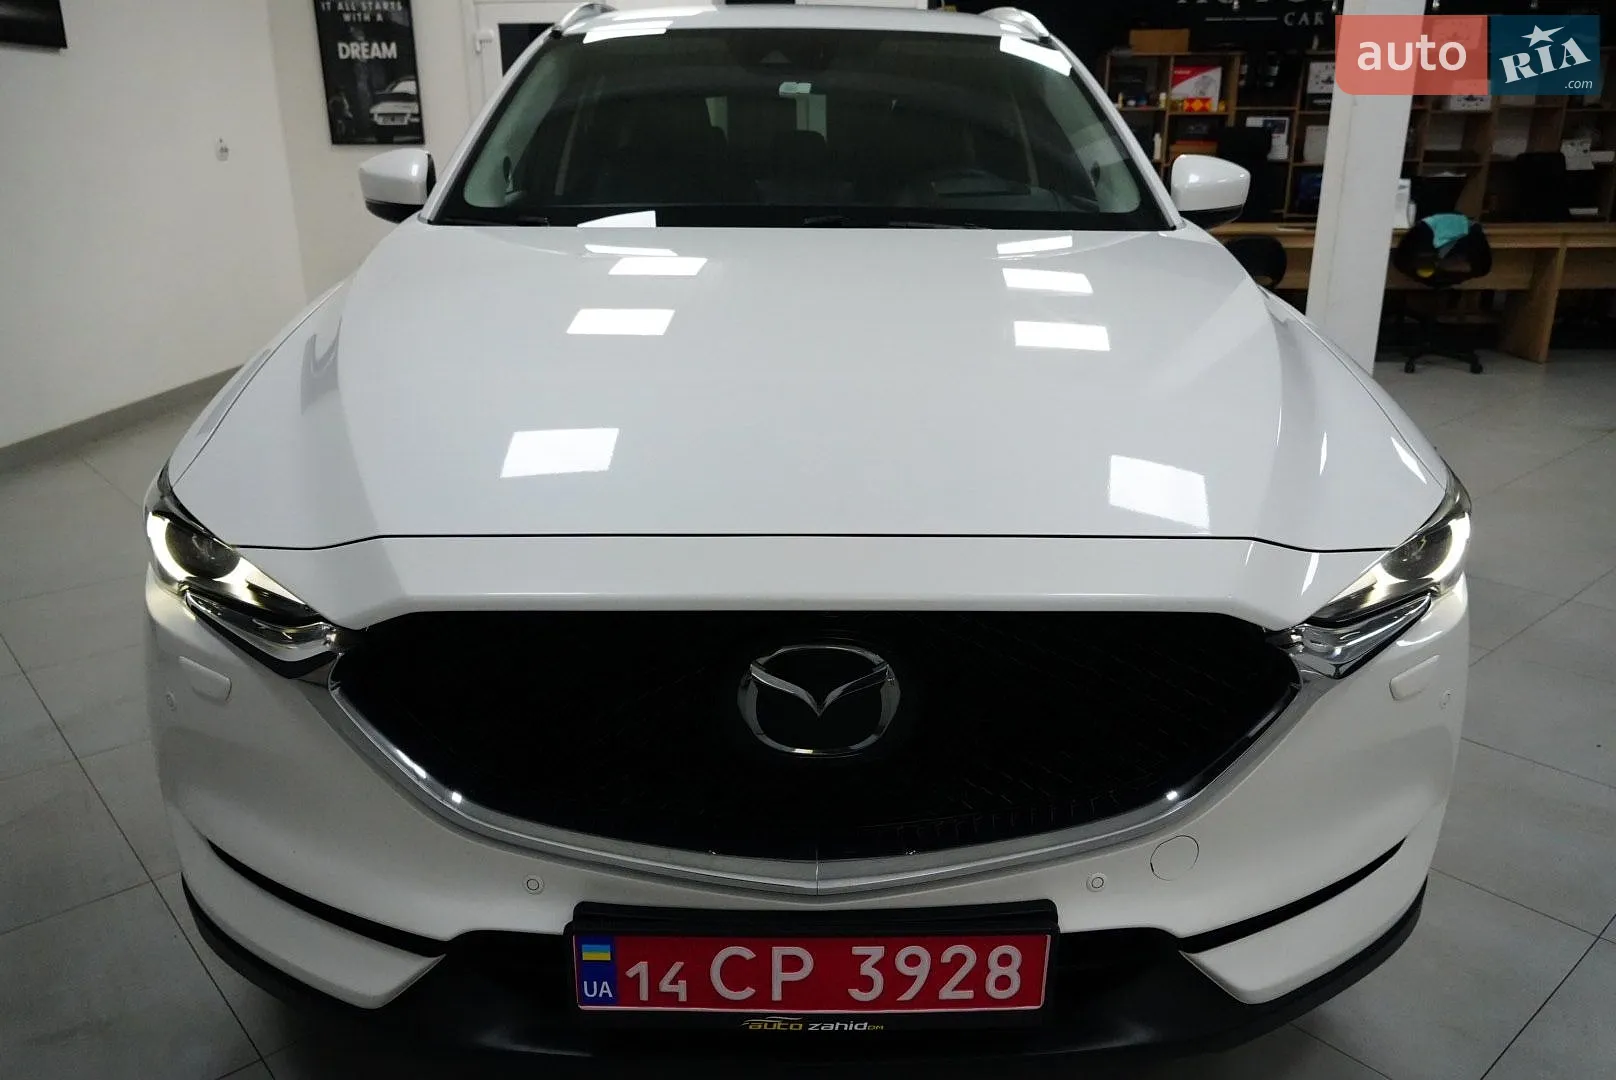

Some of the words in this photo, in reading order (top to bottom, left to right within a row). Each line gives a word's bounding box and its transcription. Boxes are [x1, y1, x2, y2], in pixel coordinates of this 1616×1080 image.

[320, 1, 331, 11] IT
[337, 1, 356, 11] ALL
[361, 1, 402, 11] STARTS
[342, 12, 371, 22] WITH
[376, 13, 383, 22] A
[337, 41, 397, 60] DREAM
[625, 961, 687, 1002] 14
[709, 945, 814, 1001] CP
[847, 944, 1023, 1001] 3928
[583, 981, 613, 998] UA
